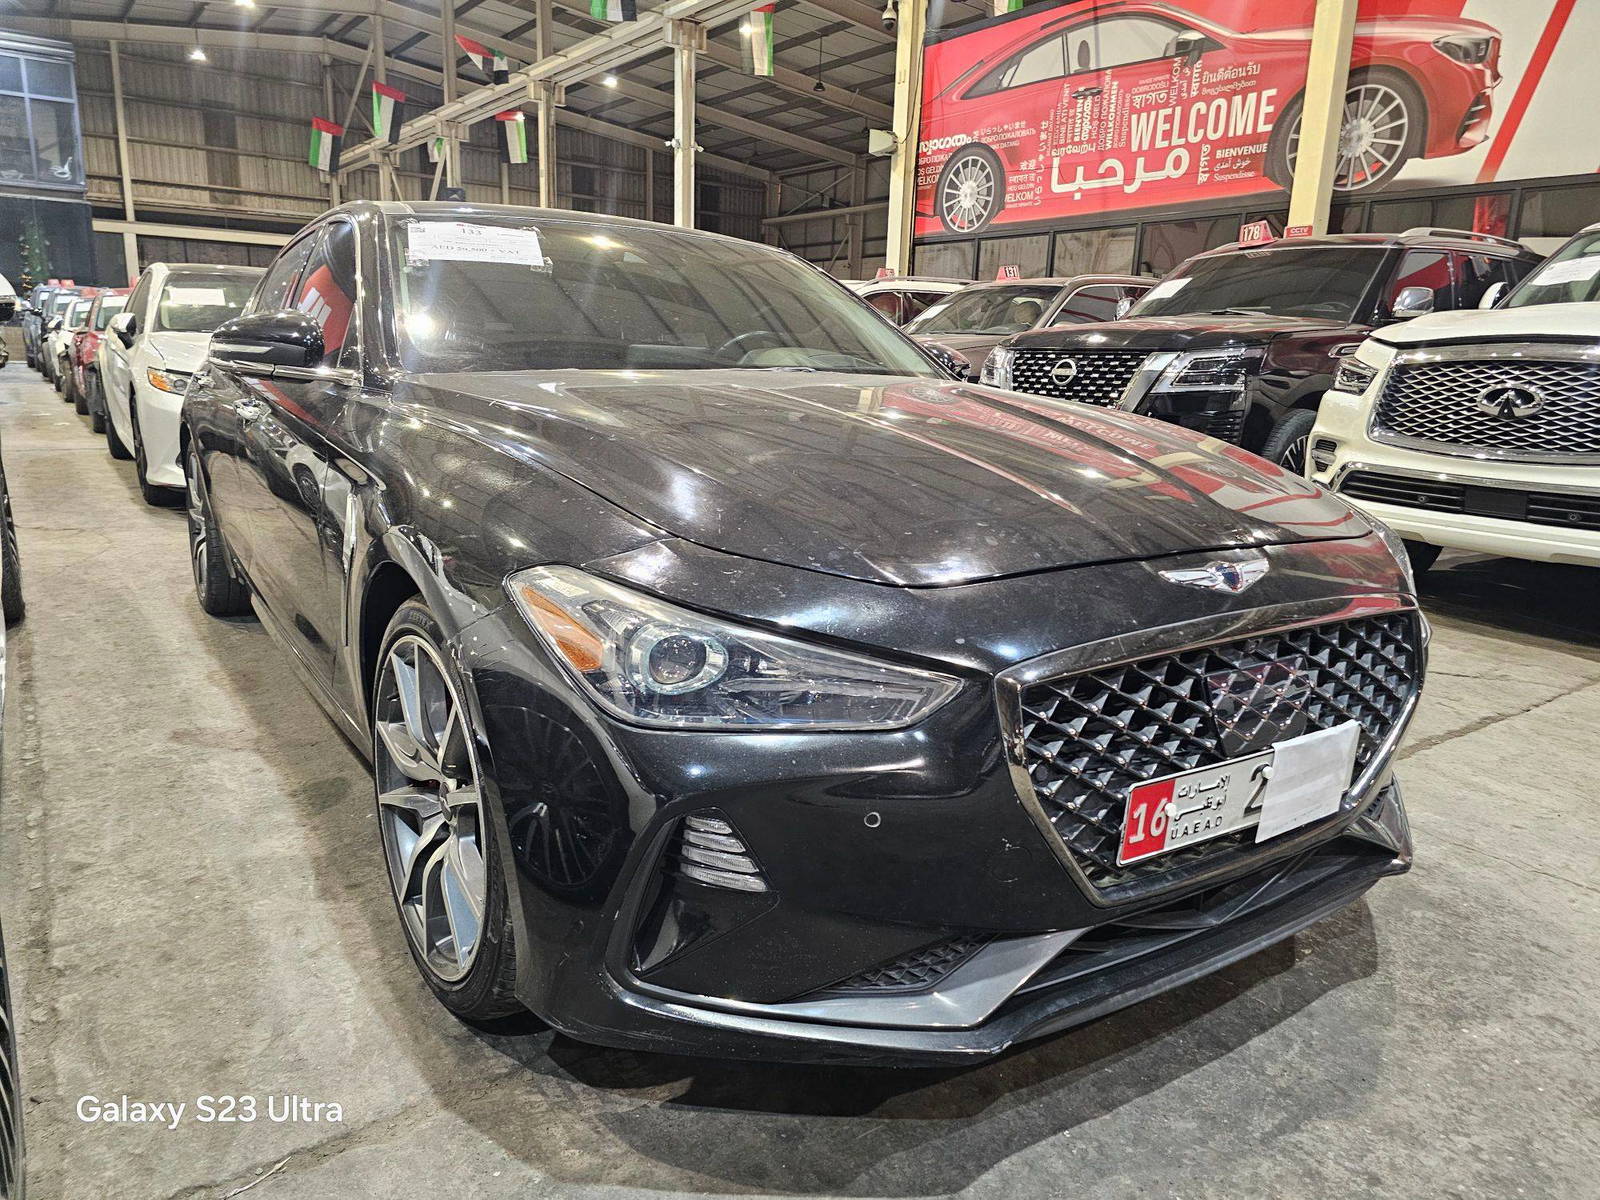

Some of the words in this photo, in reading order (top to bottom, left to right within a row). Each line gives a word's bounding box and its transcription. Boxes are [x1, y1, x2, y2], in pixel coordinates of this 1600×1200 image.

[1168, 57, 1182, 106] WELKOM
[1074, 87, 1086, 141] BIENVENI
[1105, 81, 1119, 151] WILLKOMMEN
[1131, 88, 1278, 152] WELCOME
[1050, 148, 1191, 200] مرحبا
[1215, 143, 1268, 159] BIENVENUE
[1244, 226, 1260, 241] 178
[1005, 266, 1018, 278] 131
[1129, 798, 1168, 844] 16
